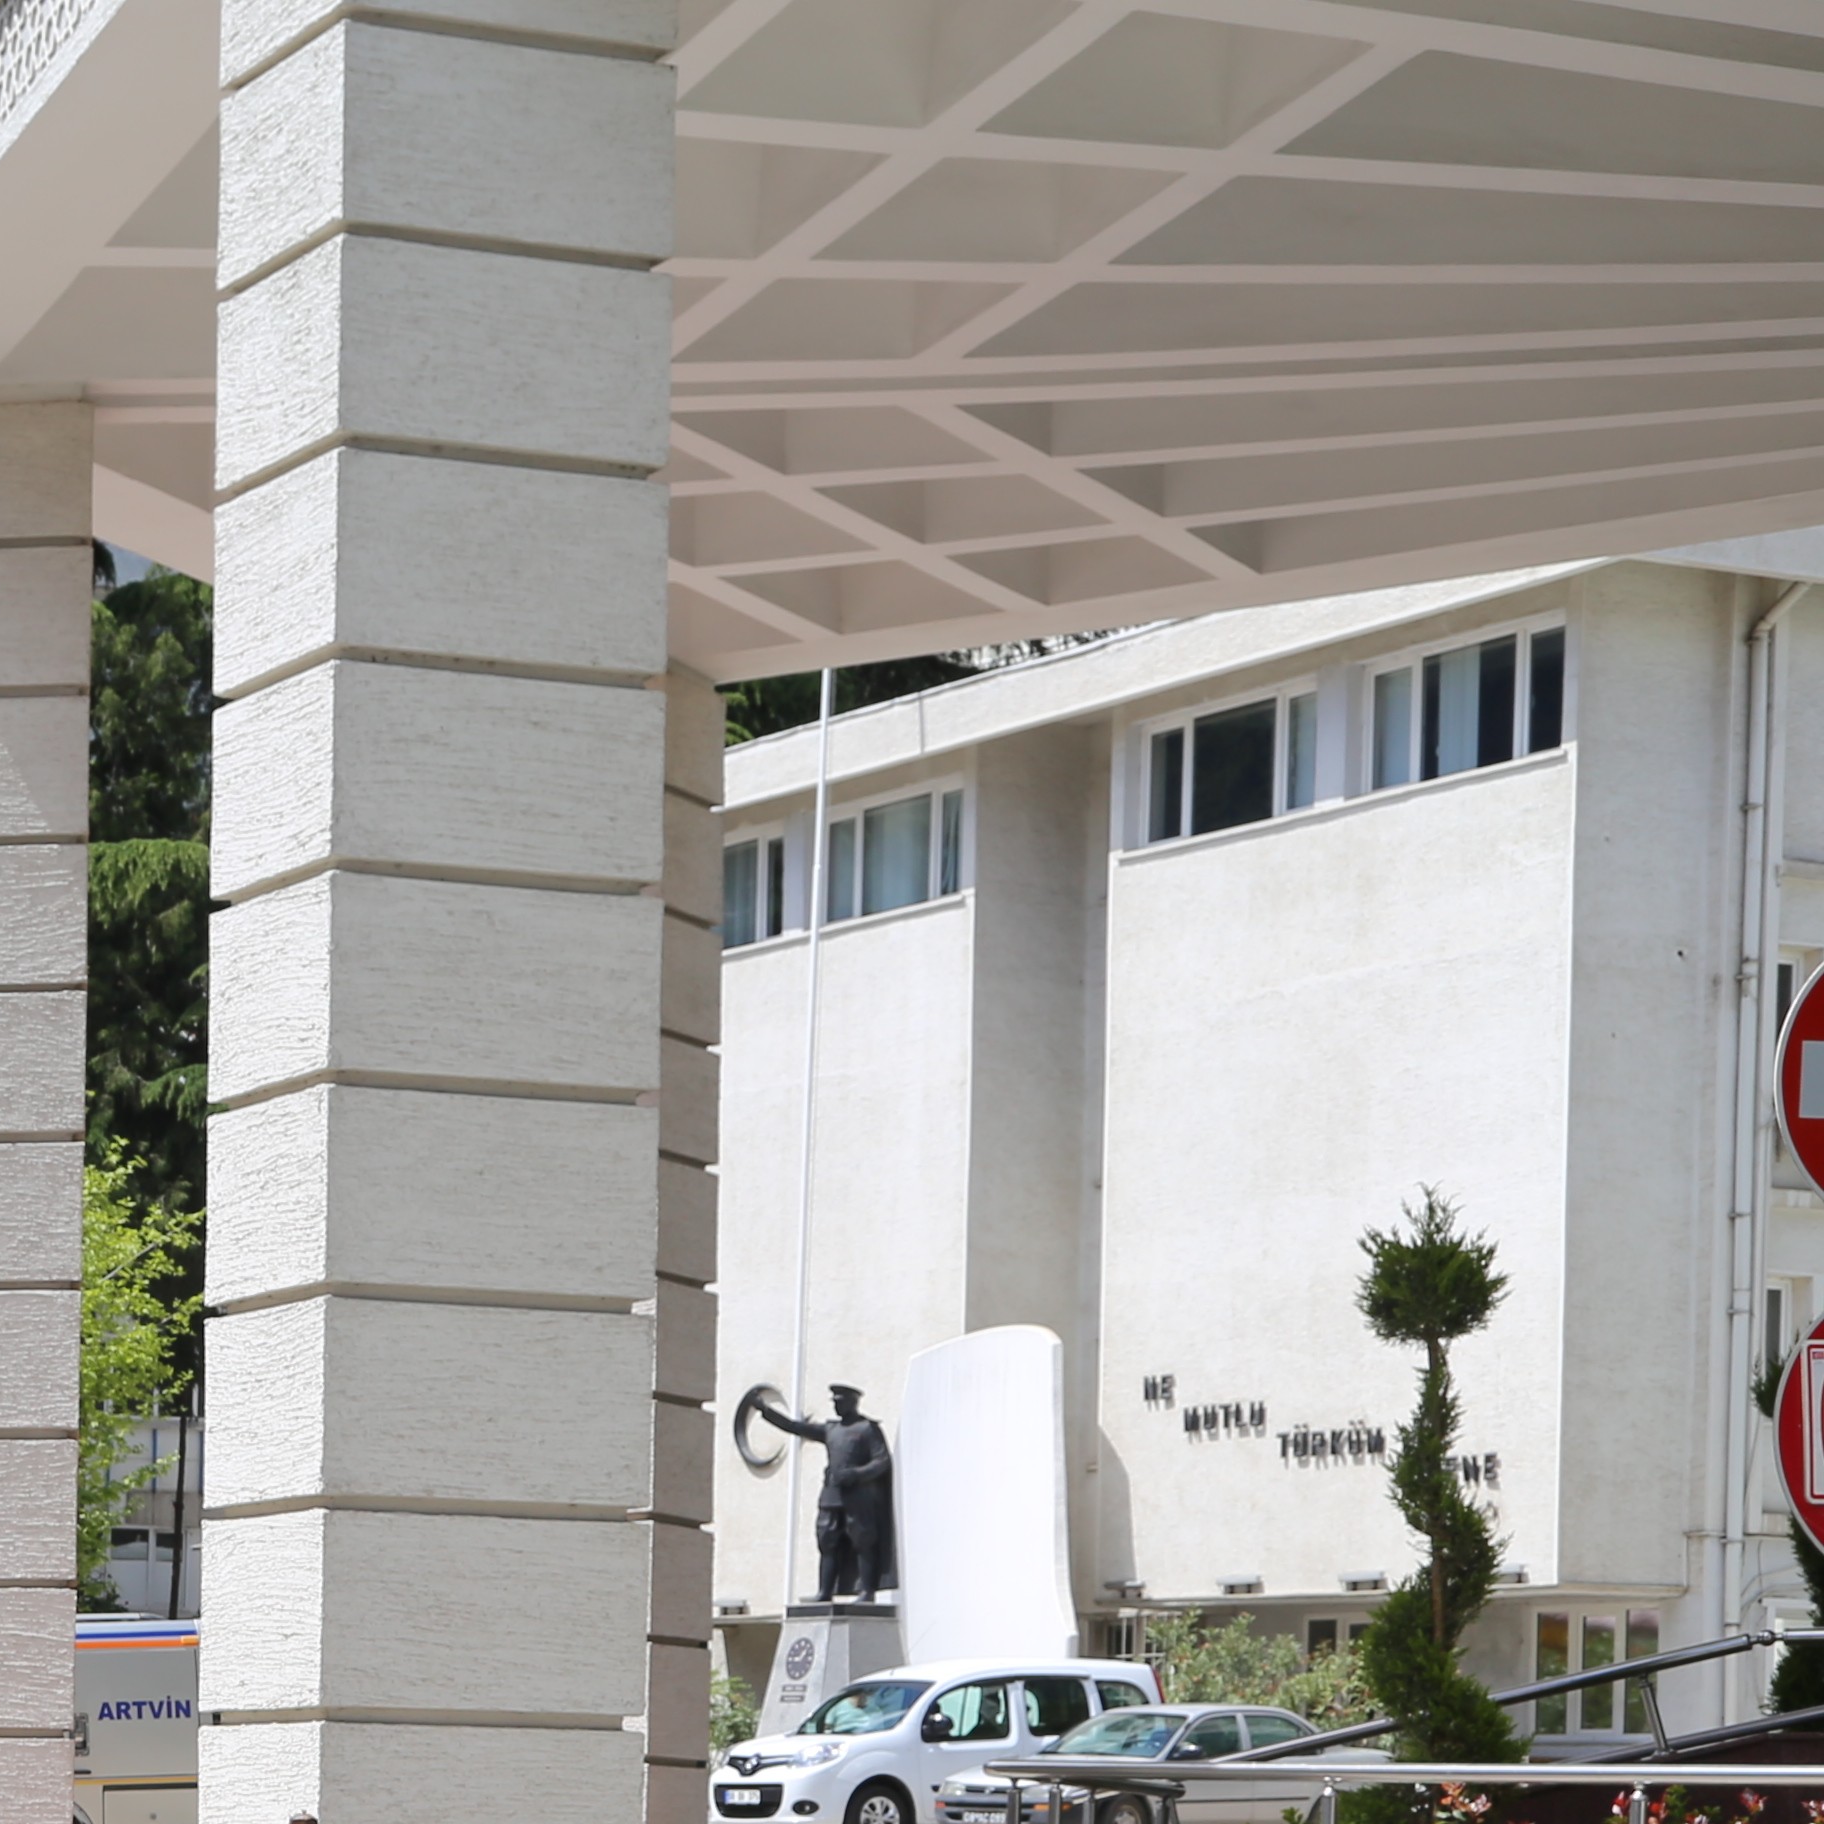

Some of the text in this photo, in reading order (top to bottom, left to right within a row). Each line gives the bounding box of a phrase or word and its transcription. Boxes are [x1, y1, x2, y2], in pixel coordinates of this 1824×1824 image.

[1143, 1374, 1175, 1402] NE
[1184, 1401, 1266, 1433] MUTLU
[1276, 1418, 1386, 1459] TÜRKÜM
[97, 1695, 192, 1721] ARTVİN
